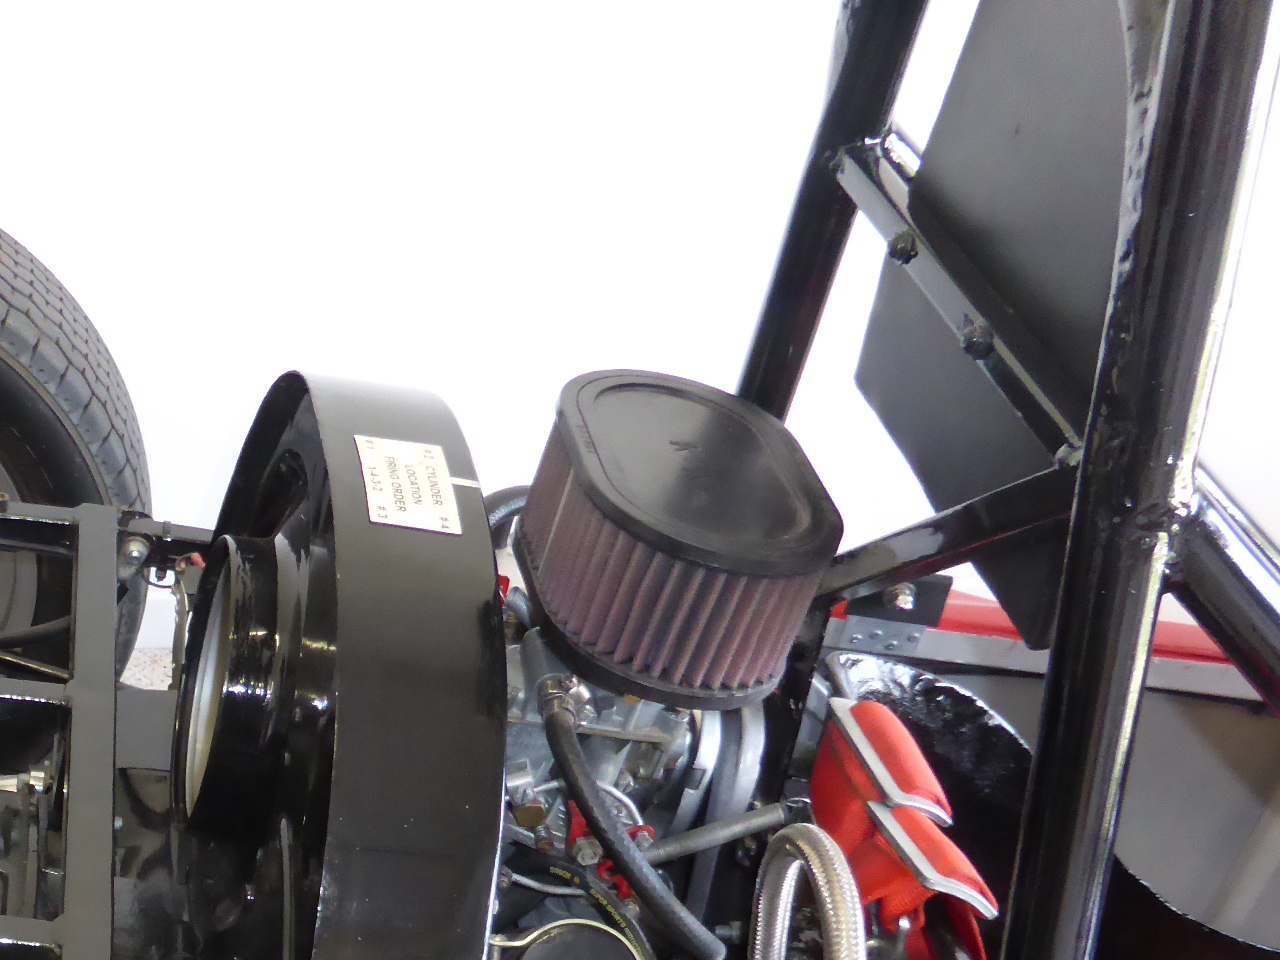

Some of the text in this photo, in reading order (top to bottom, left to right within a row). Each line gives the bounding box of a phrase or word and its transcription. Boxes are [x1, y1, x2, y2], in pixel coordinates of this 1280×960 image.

[384, 456, 407, 512] FIRING ORDER
[405, 464, 423, 505] LOCATION
[426, 465, 443, 506] CYLINDER
